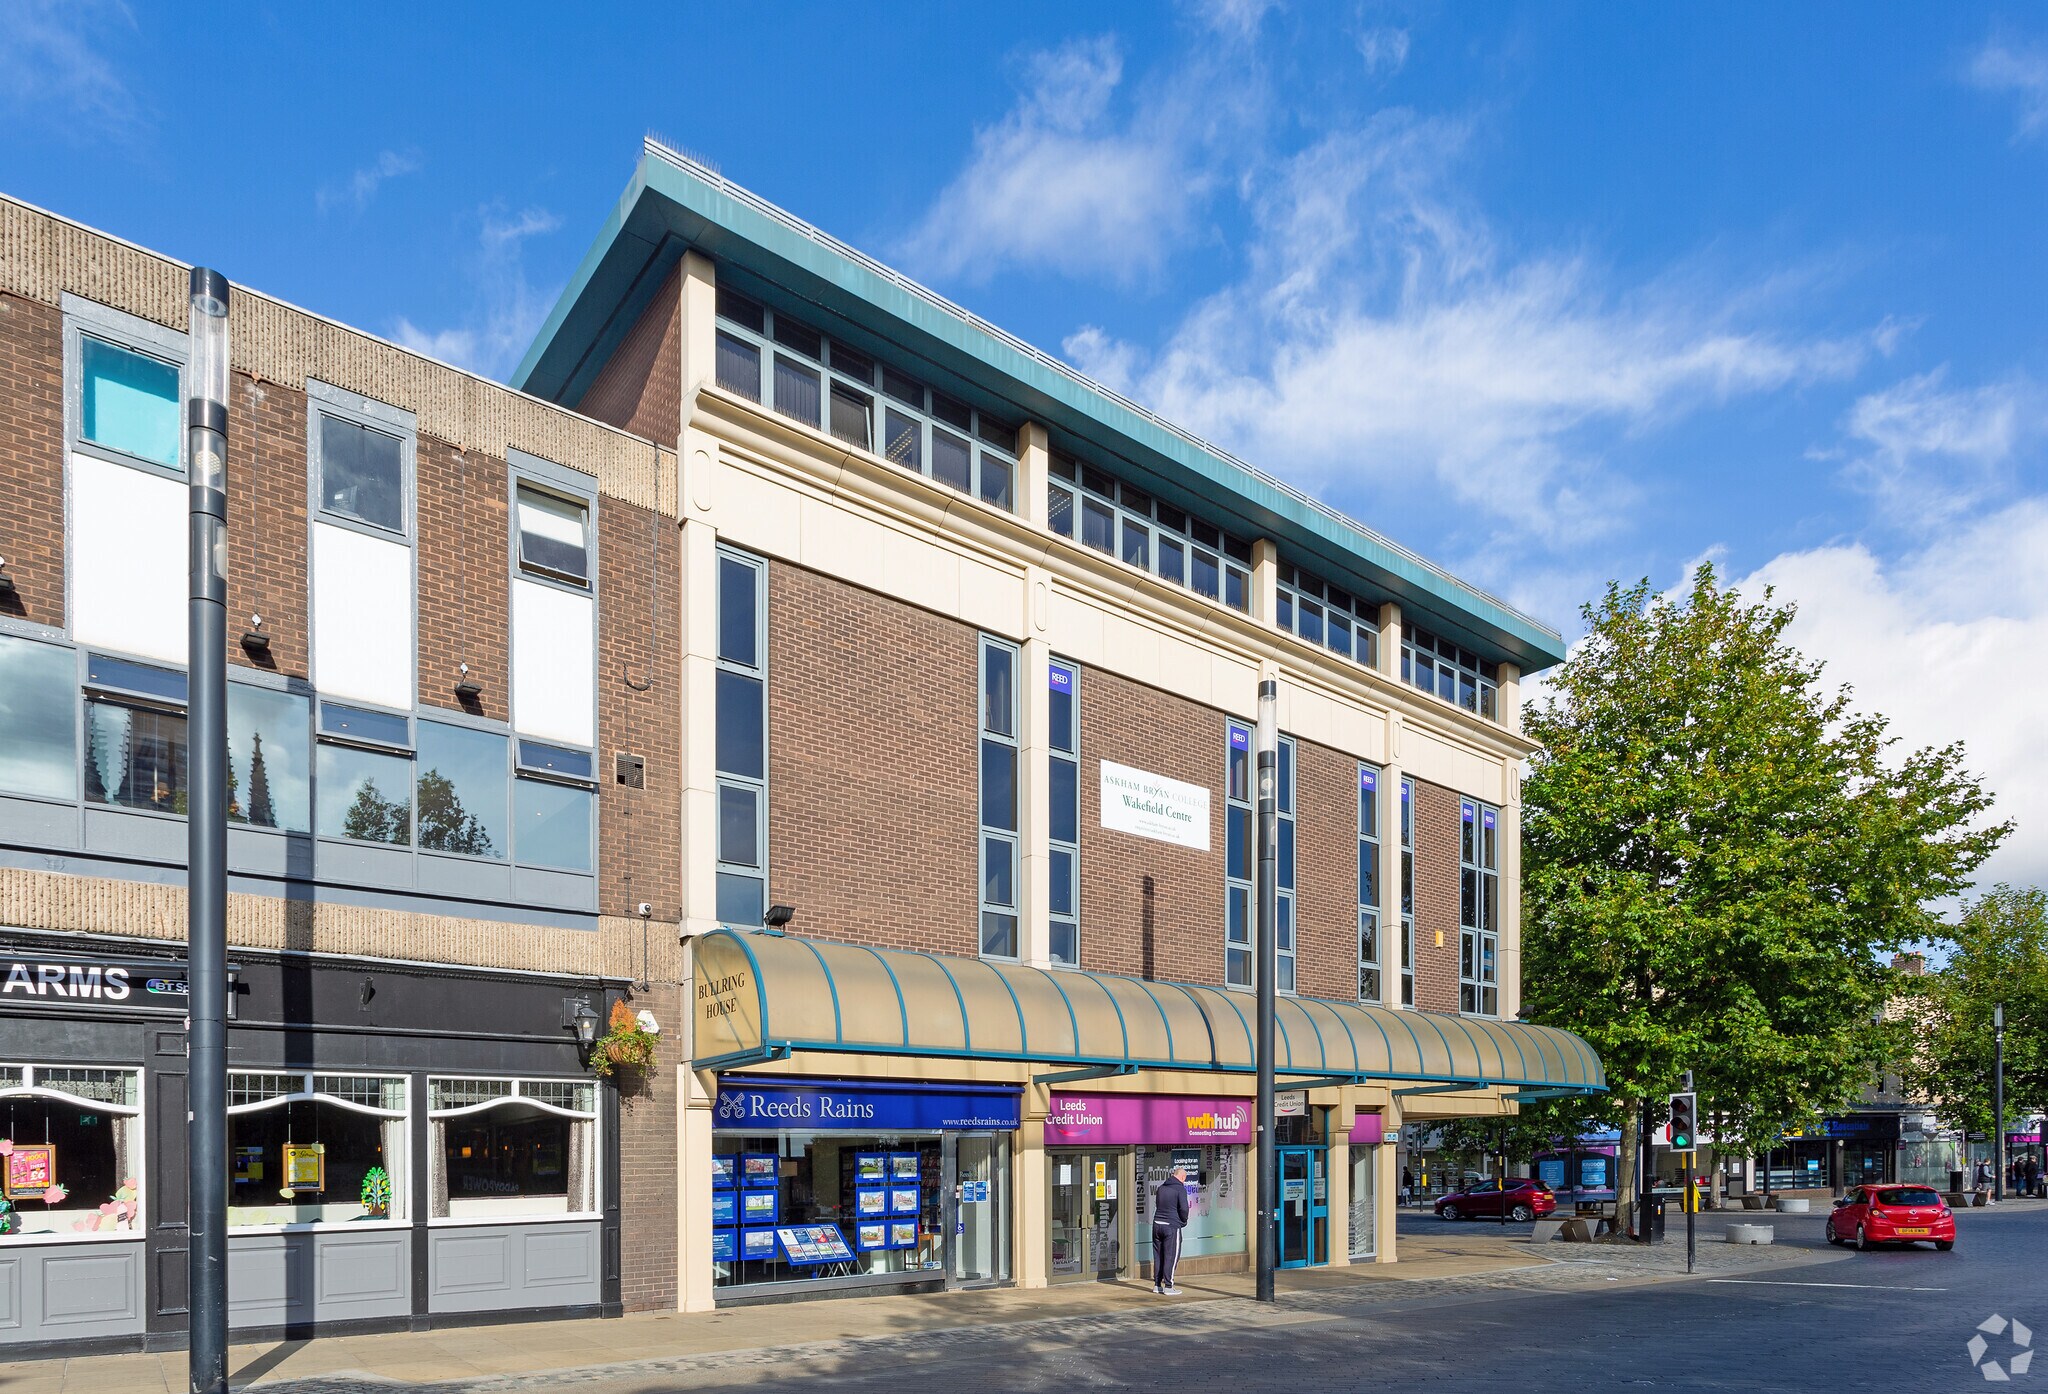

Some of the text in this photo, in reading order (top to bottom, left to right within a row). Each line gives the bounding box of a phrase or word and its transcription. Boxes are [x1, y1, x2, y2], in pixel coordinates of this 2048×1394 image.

[1051, 672, 1068, 685] REED
[1104, 775, 1208, 810] ASKHAM BRYAN COLLEGE
[1122, 794, 1193, 823] Wakefield Centre
[2, 963, 131, 1000] ARMS
[155, 981, 175, 992] BT
[698, 972, 745, 1000] BULLRING
[706, 997, 737, 1019] HOUSE
[750, 1095, 875, 1119] Reeds Rains
[1060, 1099, 1087, 1111] Leeds
[942, 1116, 1019, 1127] www.reedsrains.co.uk
[1045, 1113, 1103, 1125] Credit Union
[31, 1170, 46, 1181] £6
[1136, 1146, 1146, 1214] Ownership
